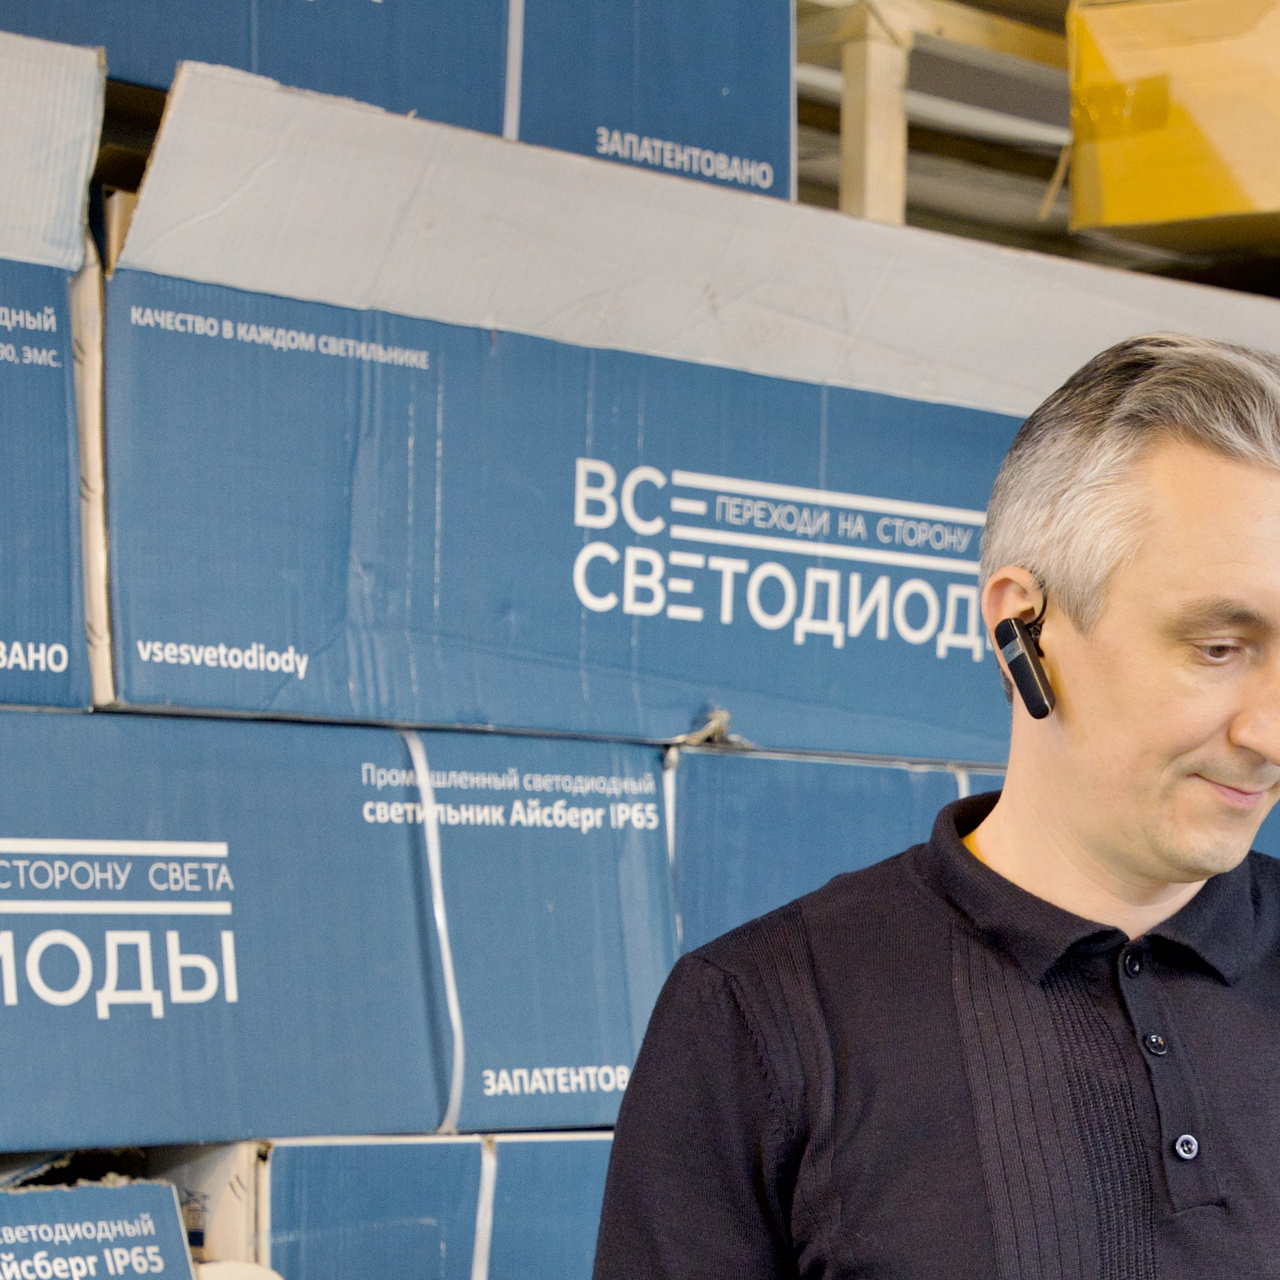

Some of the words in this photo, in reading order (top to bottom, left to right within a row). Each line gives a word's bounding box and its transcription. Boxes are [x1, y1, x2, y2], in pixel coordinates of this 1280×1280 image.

[595, 126, 774, 189] ЗАПАТЕНТОВАНО
[131, 305, 219, 337] КАЧЕСТВО
[222, 319, 234, 339] В
[237, 322, 315, 351] КАЖДОМ
[318, 335, 430, 370] СВЕТИЛЬНИКЕ
[716, 495, 830, 538] ПЕРЕХОДИ
[838, 512, 868, 540] НА
[876, 517, 973, 553] СТОРОНУ
[573, 541, 992, 662] СВЕТОДИОД
[136, 640, 309, 680] vsesvetodiody
[361, 762, 518, 790] Промшленный
[522, 772, 656, 797] светодиодный
[509, 799, 606, 834] Айсберг
[610, 802, 659, 830] IP65
[148, 861, 235, 891] СВЕТА
[103, 1244, 165, 1276] IP65
